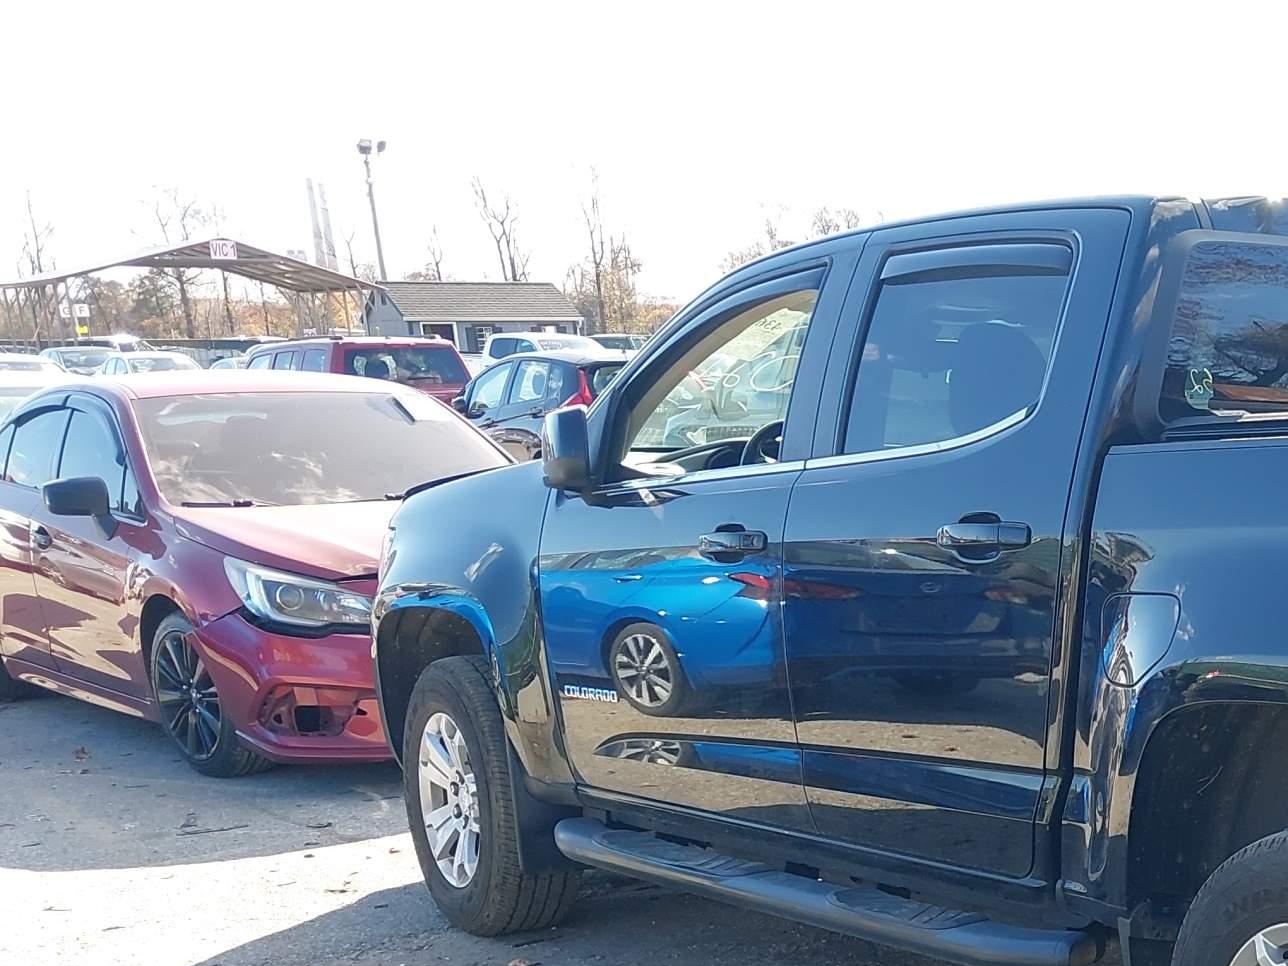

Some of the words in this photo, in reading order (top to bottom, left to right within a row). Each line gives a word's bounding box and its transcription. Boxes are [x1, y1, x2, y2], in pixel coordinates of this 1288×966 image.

[210, 242, 229, 257] VIC
[230, 243, 237, 257] 1
[78, 306, 86, 315] F
[564, 684, 617, 703] COLORADO
